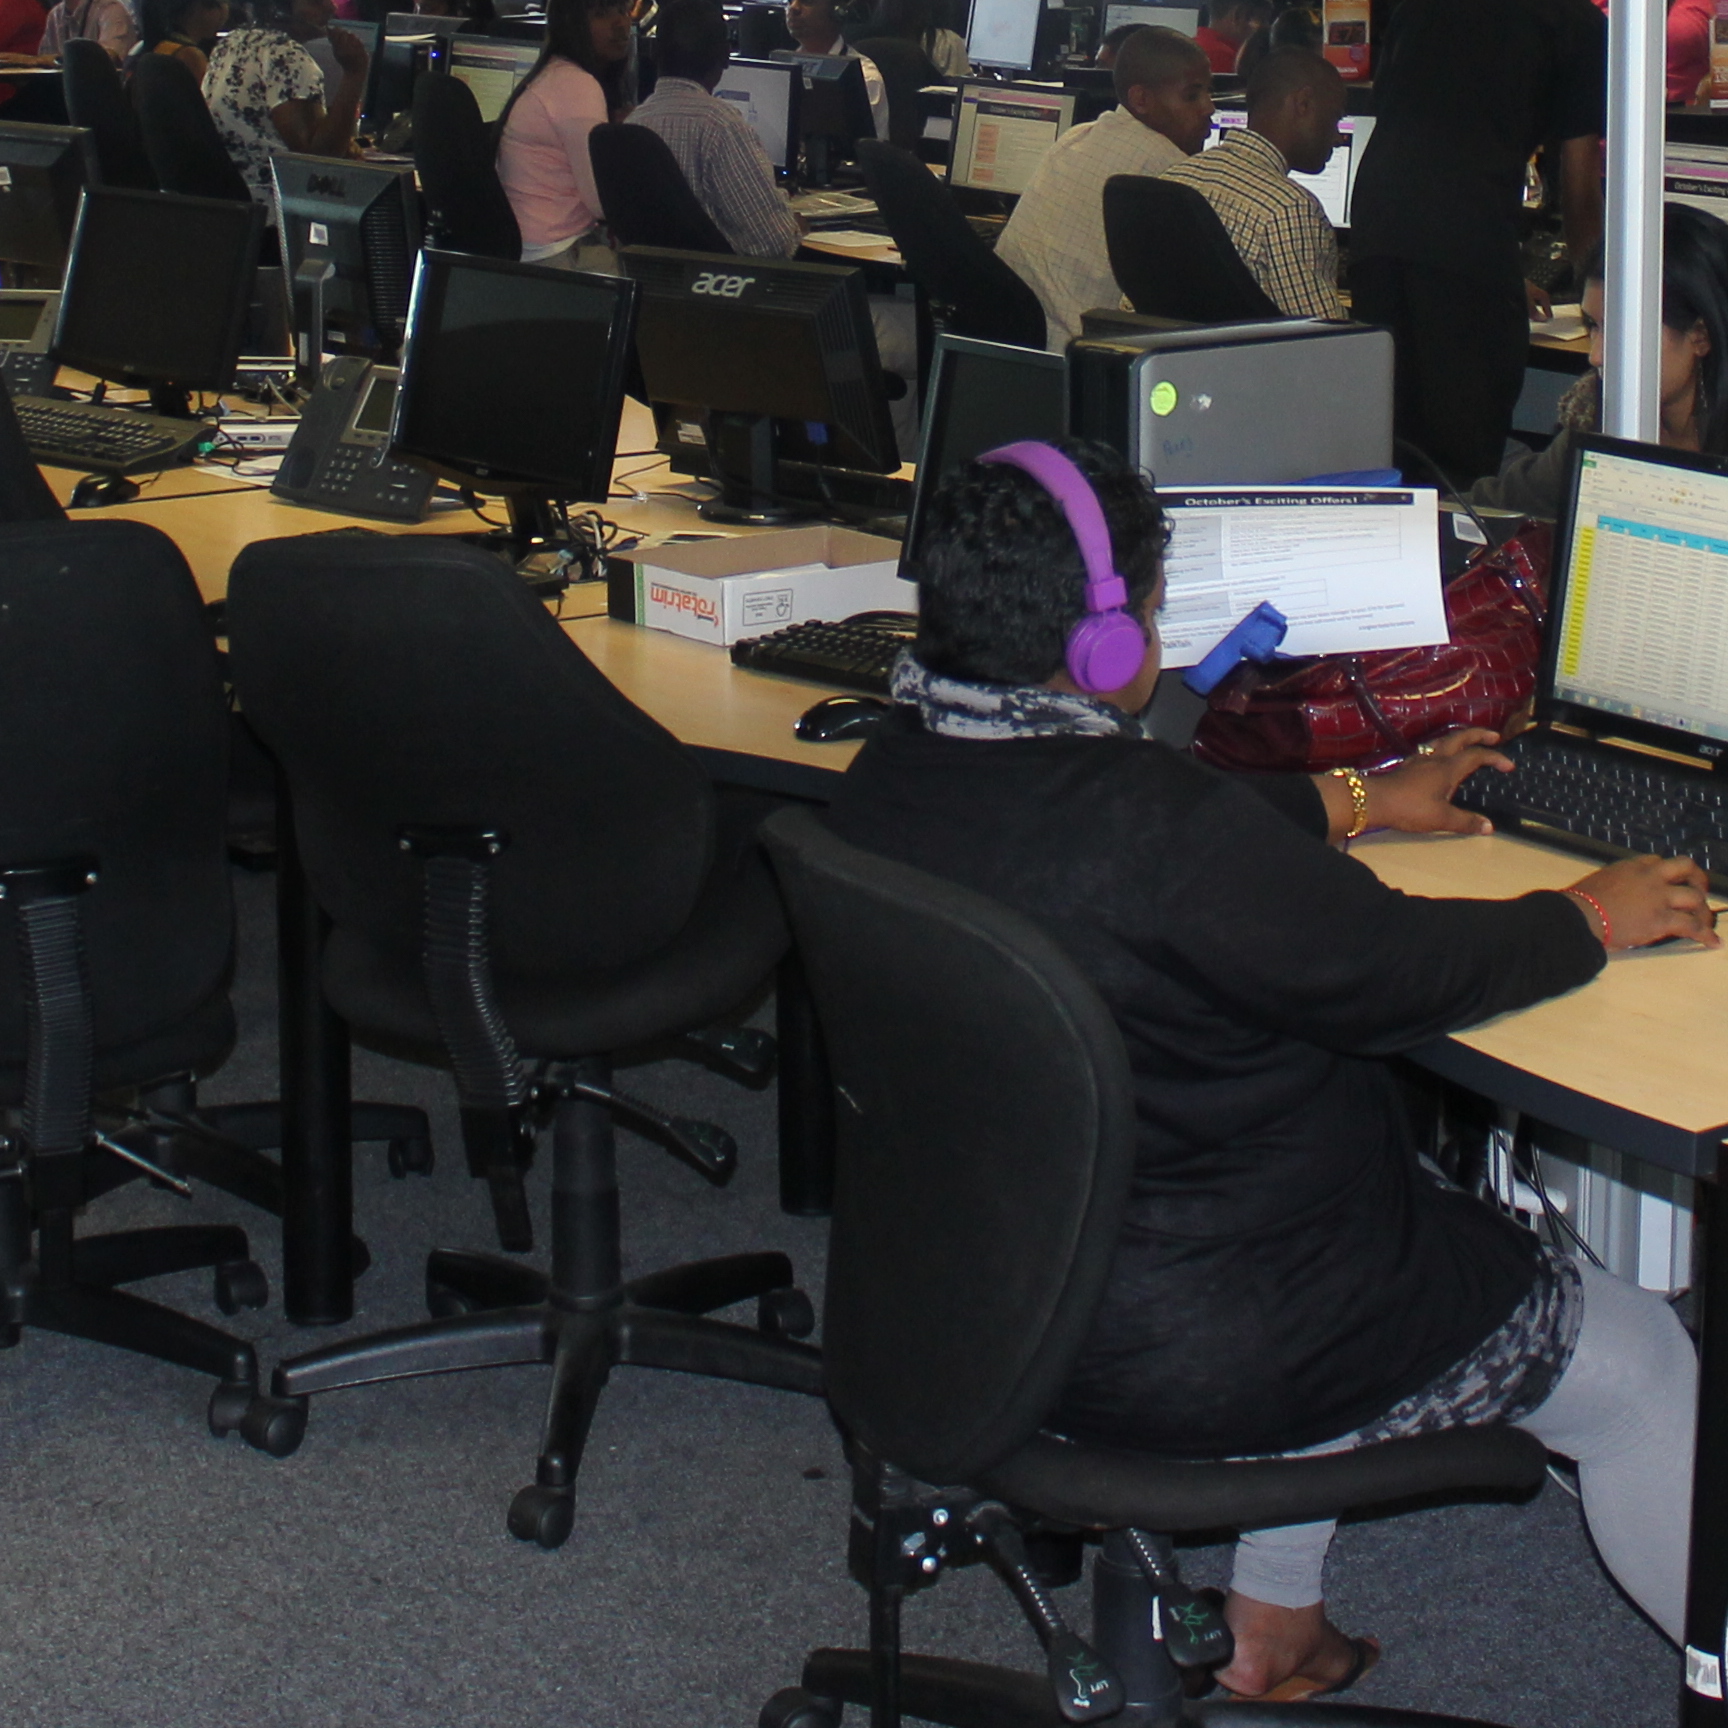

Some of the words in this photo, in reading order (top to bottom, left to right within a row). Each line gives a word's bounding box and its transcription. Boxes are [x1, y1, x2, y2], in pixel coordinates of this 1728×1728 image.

[691, 272, 755, 299] acer
[1184, 495, 1252, 507] October's
[1254, 495, 1308, 507] Exciting
[1310, 494, 1358, 506] Offers!
[650, 586, 717, 624] rotatrim
[1699, 743, 1724, 757] acer
